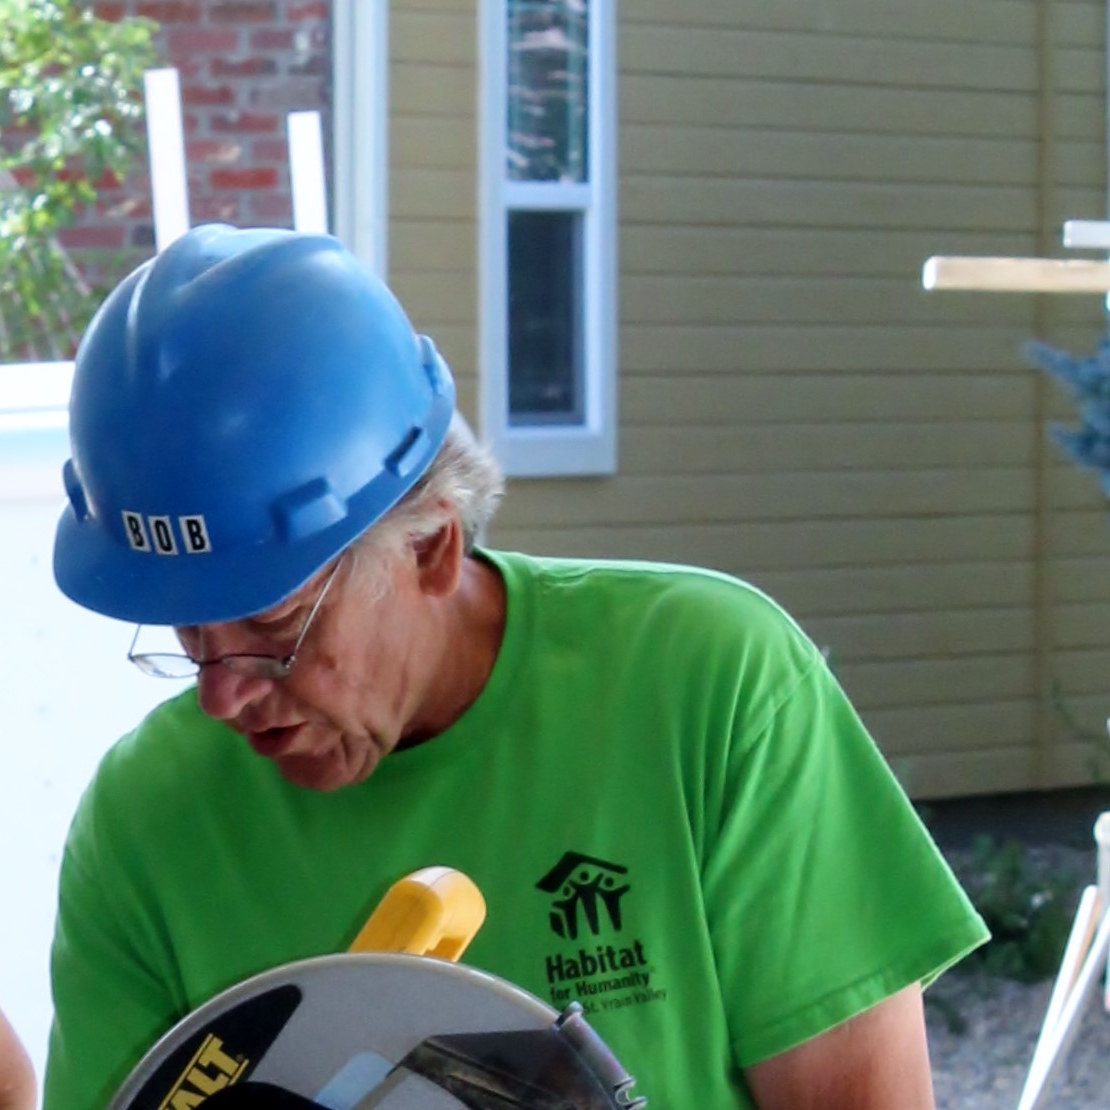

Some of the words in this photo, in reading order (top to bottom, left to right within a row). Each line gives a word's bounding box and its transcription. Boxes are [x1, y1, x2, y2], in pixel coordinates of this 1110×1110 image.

[126, 515, 207, 552] BOB
[545, 940, 648, 984] Habitat
[550, 985, 570, 1002] for
[576, 972, 649, 997] Humanity
